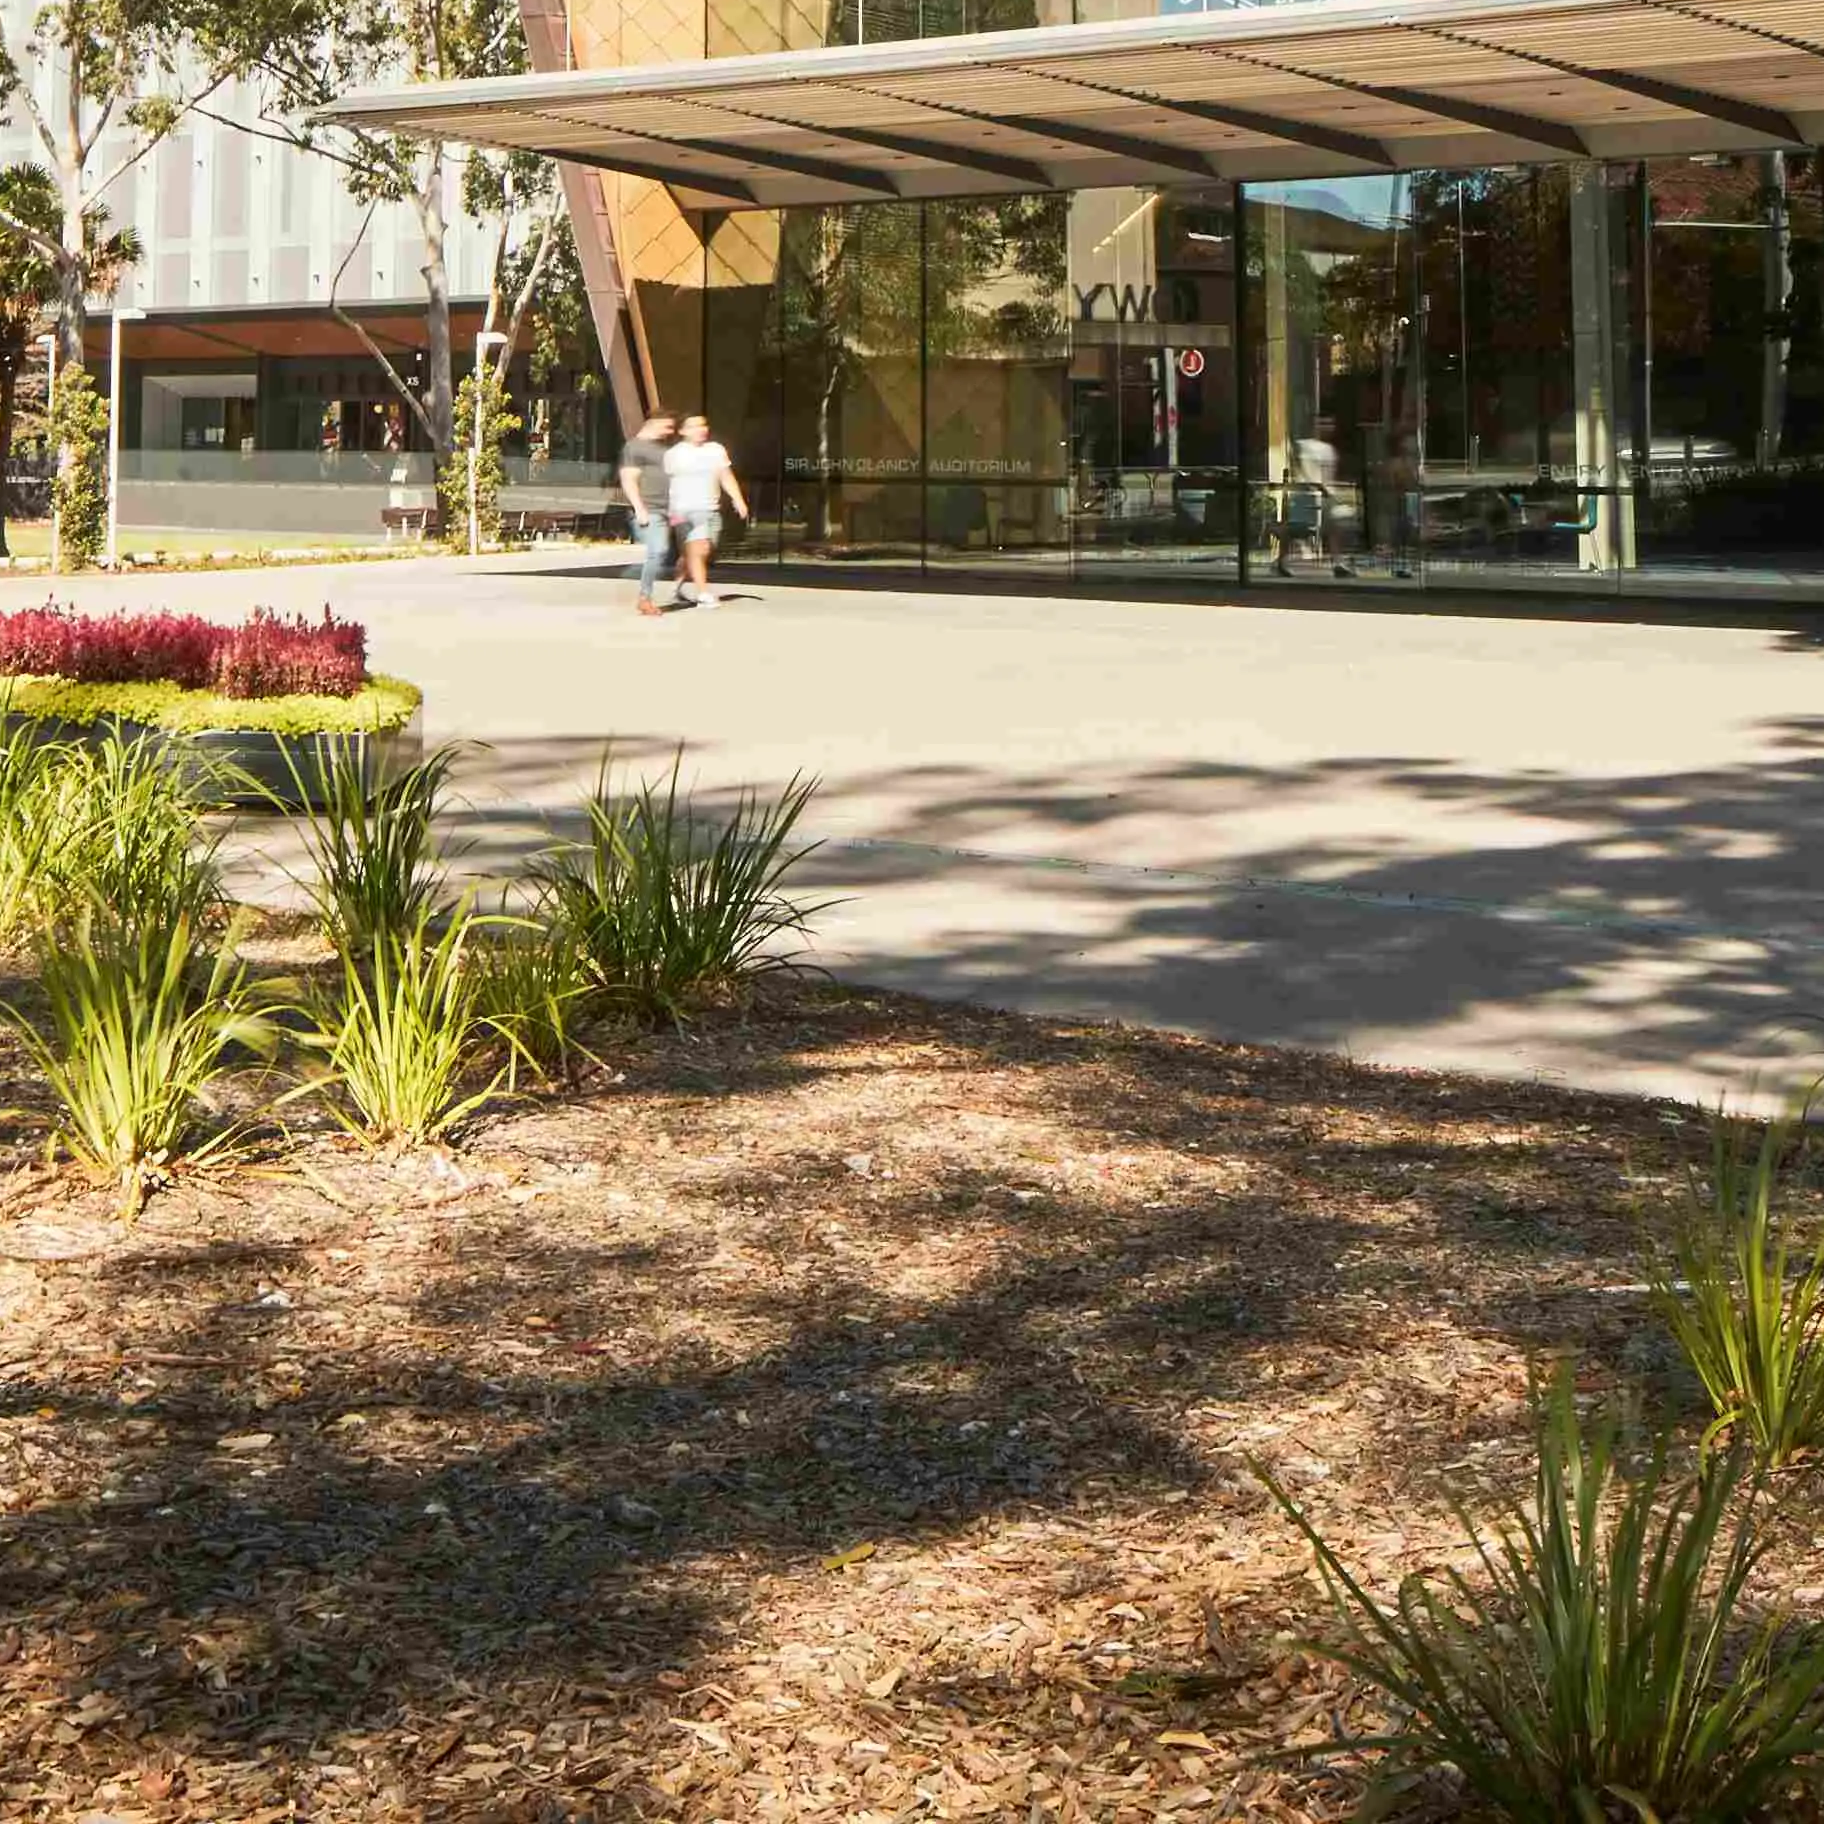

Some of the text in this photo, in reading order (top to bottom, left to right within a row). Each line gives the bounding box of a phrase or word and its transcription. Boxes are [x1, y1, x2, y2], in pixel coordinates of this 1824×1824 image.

[784, 457, 809, 472] SIR
[811, 458, 854, 472] JOHN
[929, 459, 1033, 473] AUDITORIUM
